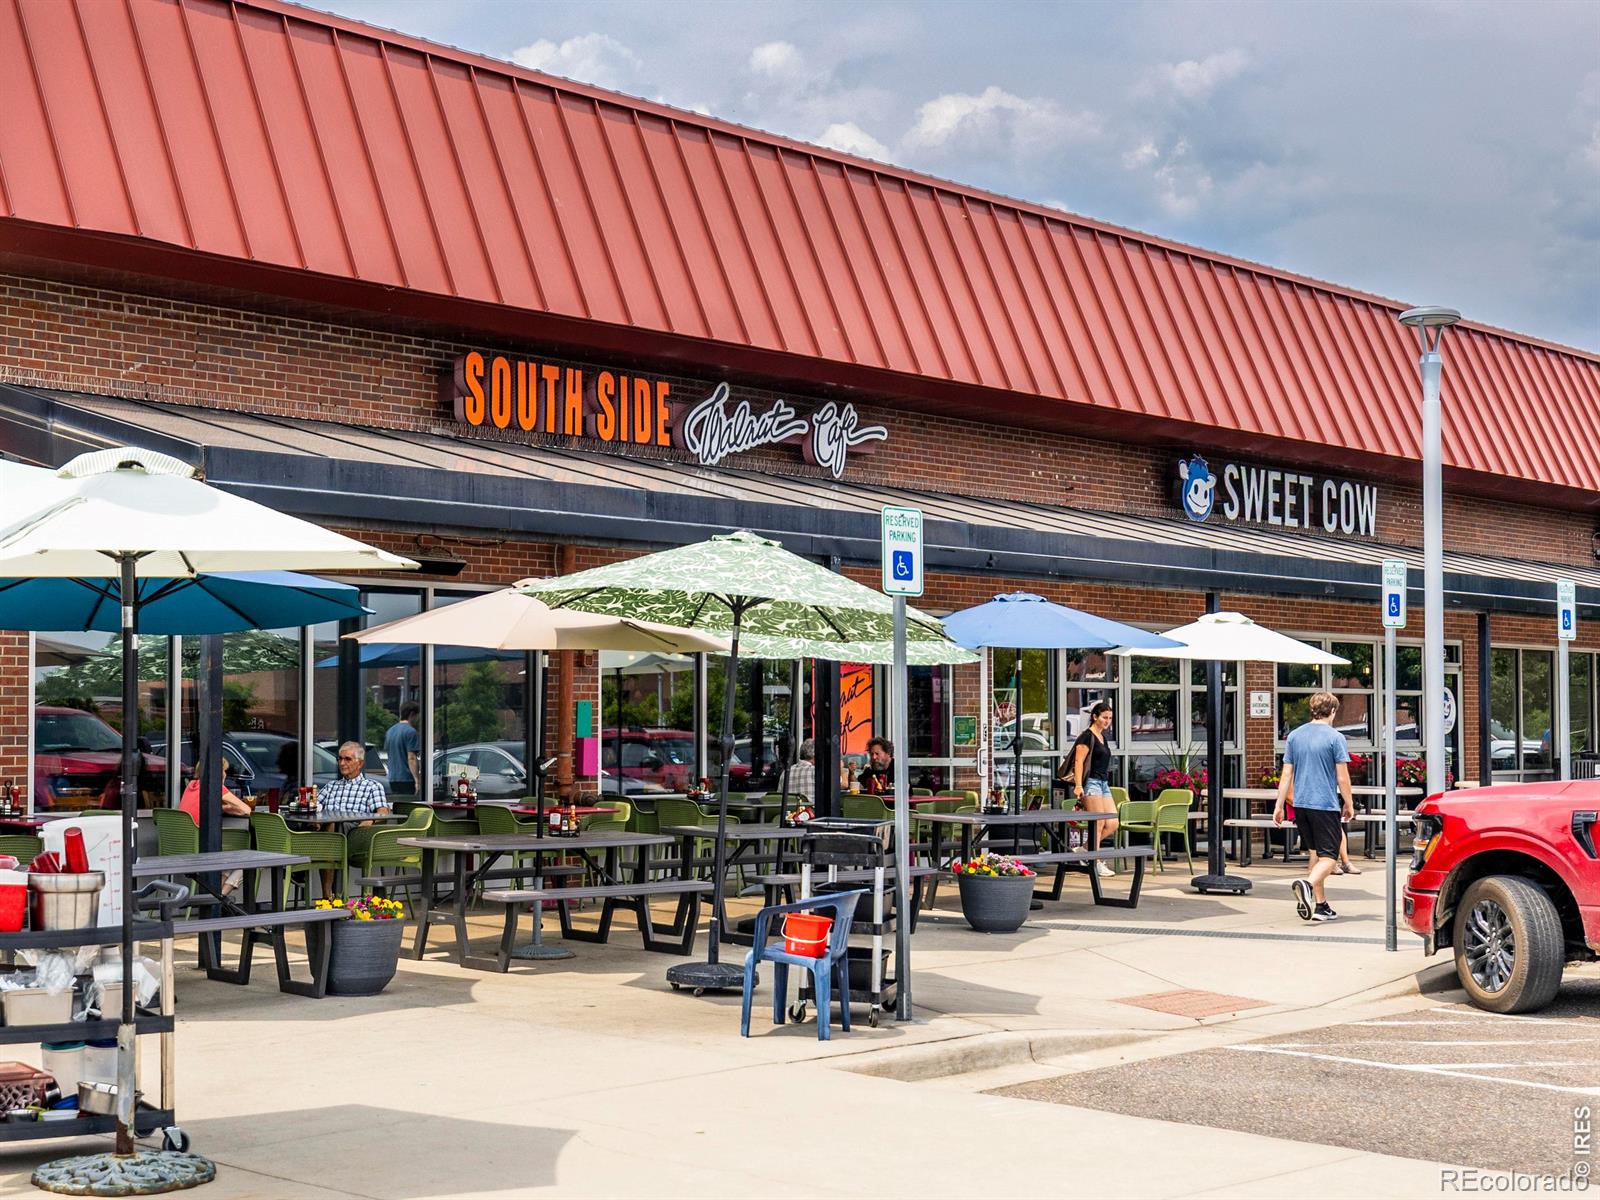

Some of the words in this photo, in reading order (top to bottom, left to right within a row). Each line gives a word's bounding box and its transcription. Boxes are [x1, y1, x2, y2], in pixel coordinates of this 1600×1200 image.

[465, 351, 582, 436] SOUTH
[597, 371, 670, 446] SIDE
[685, 382, 809, 465] Walnut
[812, 401, 888, 478] Cafe
[885, 514, 919, 528] RESERVED
[1223, 463, 1313, 529] SWEET
[1322, 479, 1377, 536] COW
[889, 530, 916, 542] PARKING
